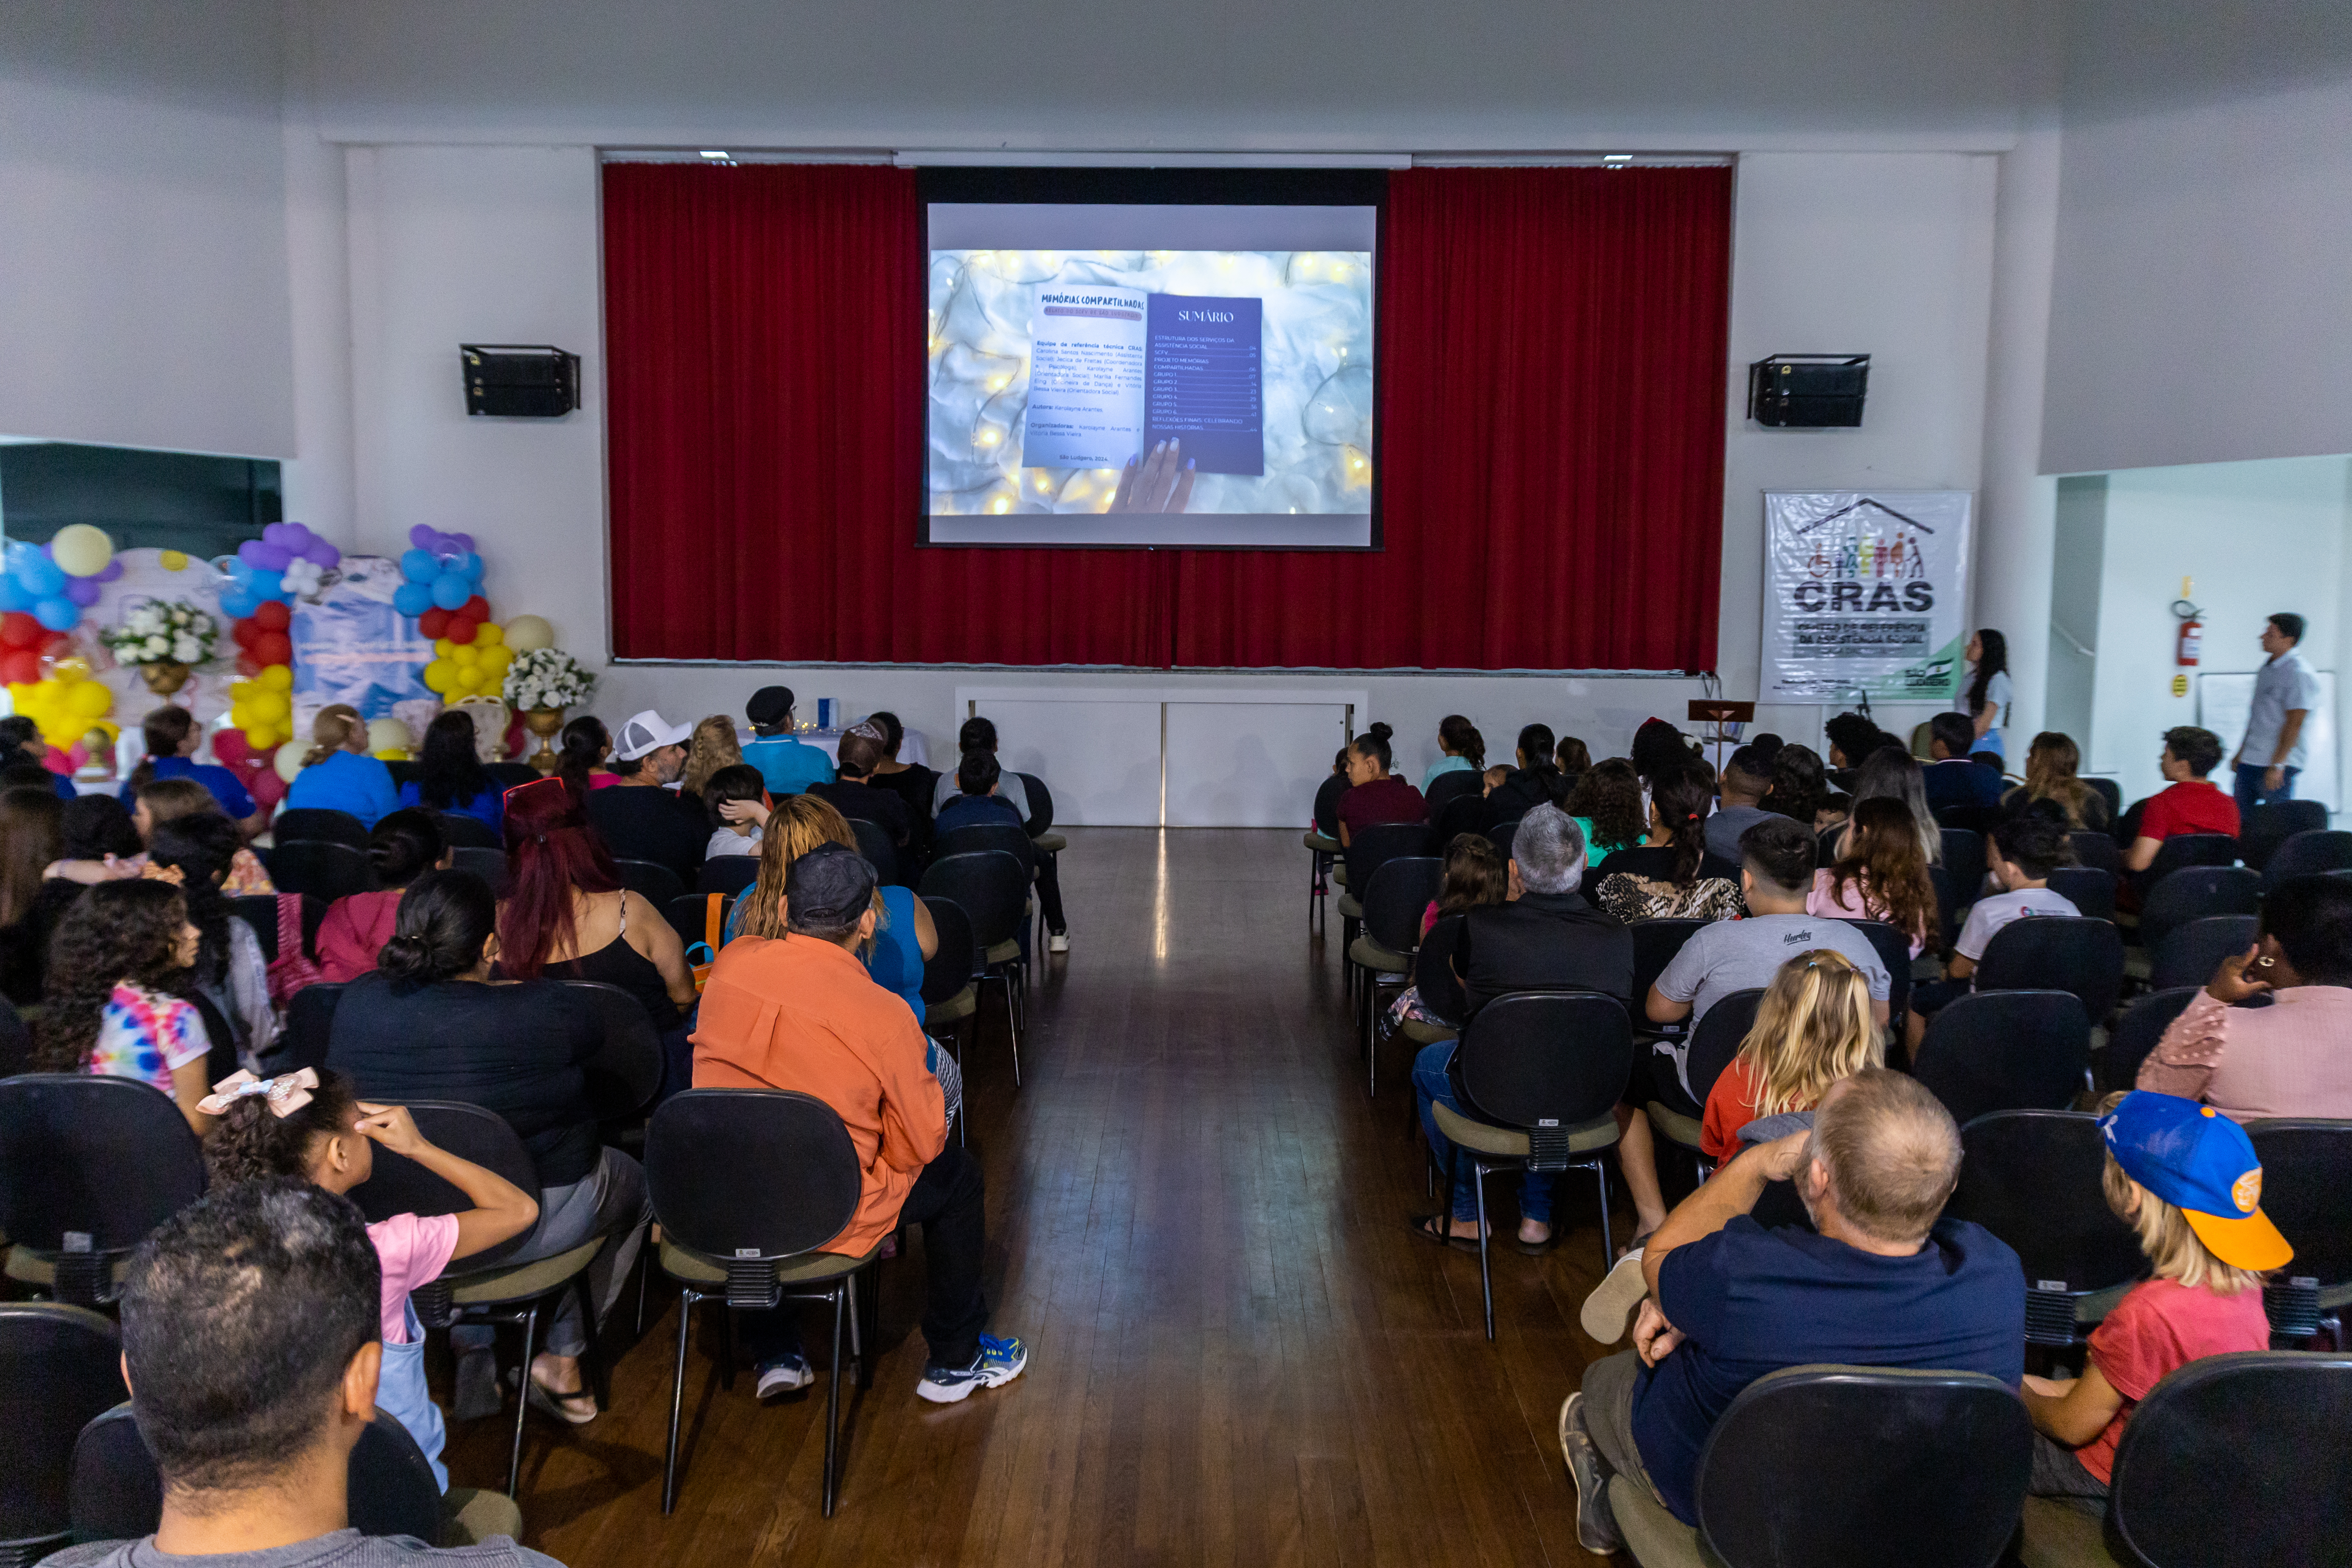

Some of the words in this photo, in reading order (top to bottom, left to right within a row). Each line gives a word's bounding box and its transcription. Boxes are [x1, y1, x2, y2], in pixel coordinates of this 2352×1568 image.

[1041, 292, 1080, 304] MEMÓRIAS
[1081, 296, 1144, 310] COMPARTILHADAS
[1178, 309, 1234, 323] SUMÁRIO
[1793, 580, 1934, 612] CRAS
[1784, 930, 1812, 944] Hurley
